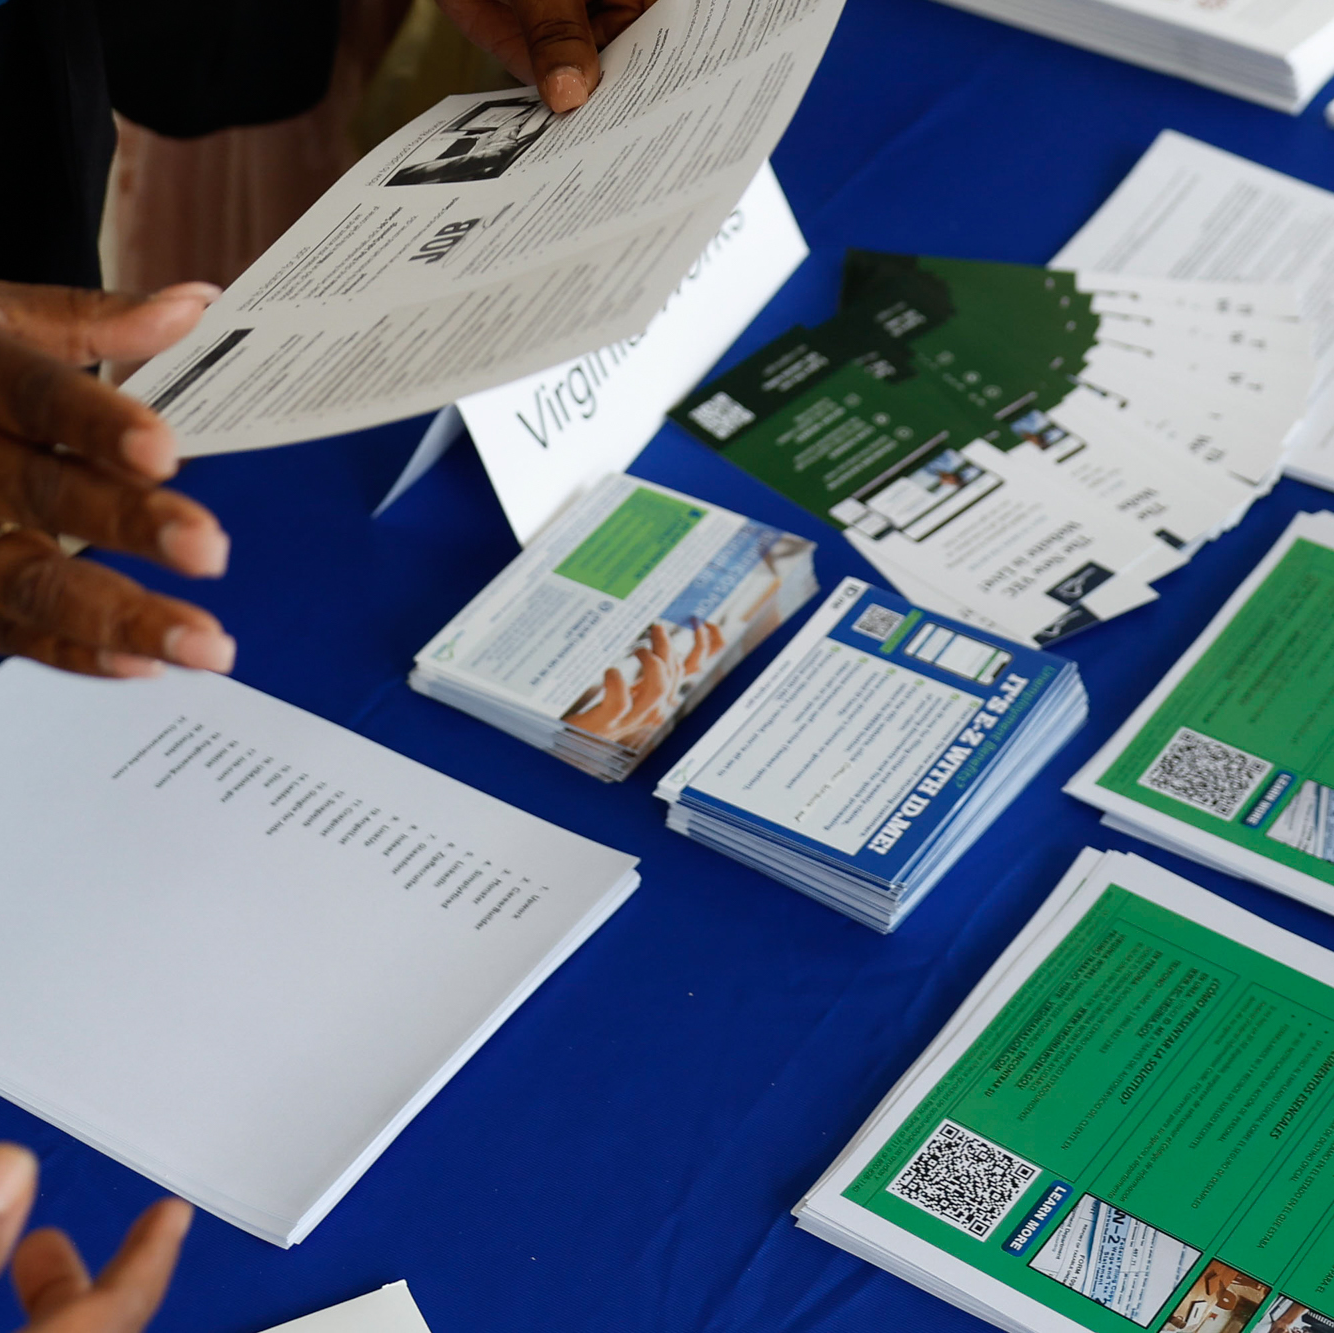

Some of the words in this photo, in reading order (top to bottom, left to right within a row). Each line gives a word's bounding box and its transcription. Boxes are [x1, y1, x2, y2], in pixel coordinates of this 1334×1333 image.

[409, 218, 480, 264] JOB
[983, 672, 1030, 713] IT'S
[955, 710, 999, 746] E-Z
[918, 742, 972, 791] WITH
[1263, 773, 1291, 801] LEARN
[865, 792, 930, 855] ID.ME!
[1244, 799, 1271, 825] MORE
[470, 877, 503, 905] Monster
[472, 885, 522, 931] CareerBuilder
[1193, 977, 1224, 1008] ¿CÓMO
[990, 999, 1056, 1072] VIRGINIAHASJOBS.COM
[1159, 1006, 1201, 1050] PRESENTAR
[1014, 1006, 1089, 1090] WWW.VIRGINIAWORKS.GOV
[1150, 1048, 1167, 1061] LA
[991, 1050, 1026, 1087] ENCONTRAR
[1115, 1058, 1159, 1105] SOLICITUD?
[983, 1085, 997, 1097] SU
[1267, 1092, 1309, 1140] ESENCIALES
[1032, 1185, 1066, 1221] LEARN
[1008, 1219, 1039, 1250] MORE
[1073, 1254, 1085, 1274] FORM
[1104, 1266, 1113, 1279] and
[1105, 1246, 1117, 1264] Wage
